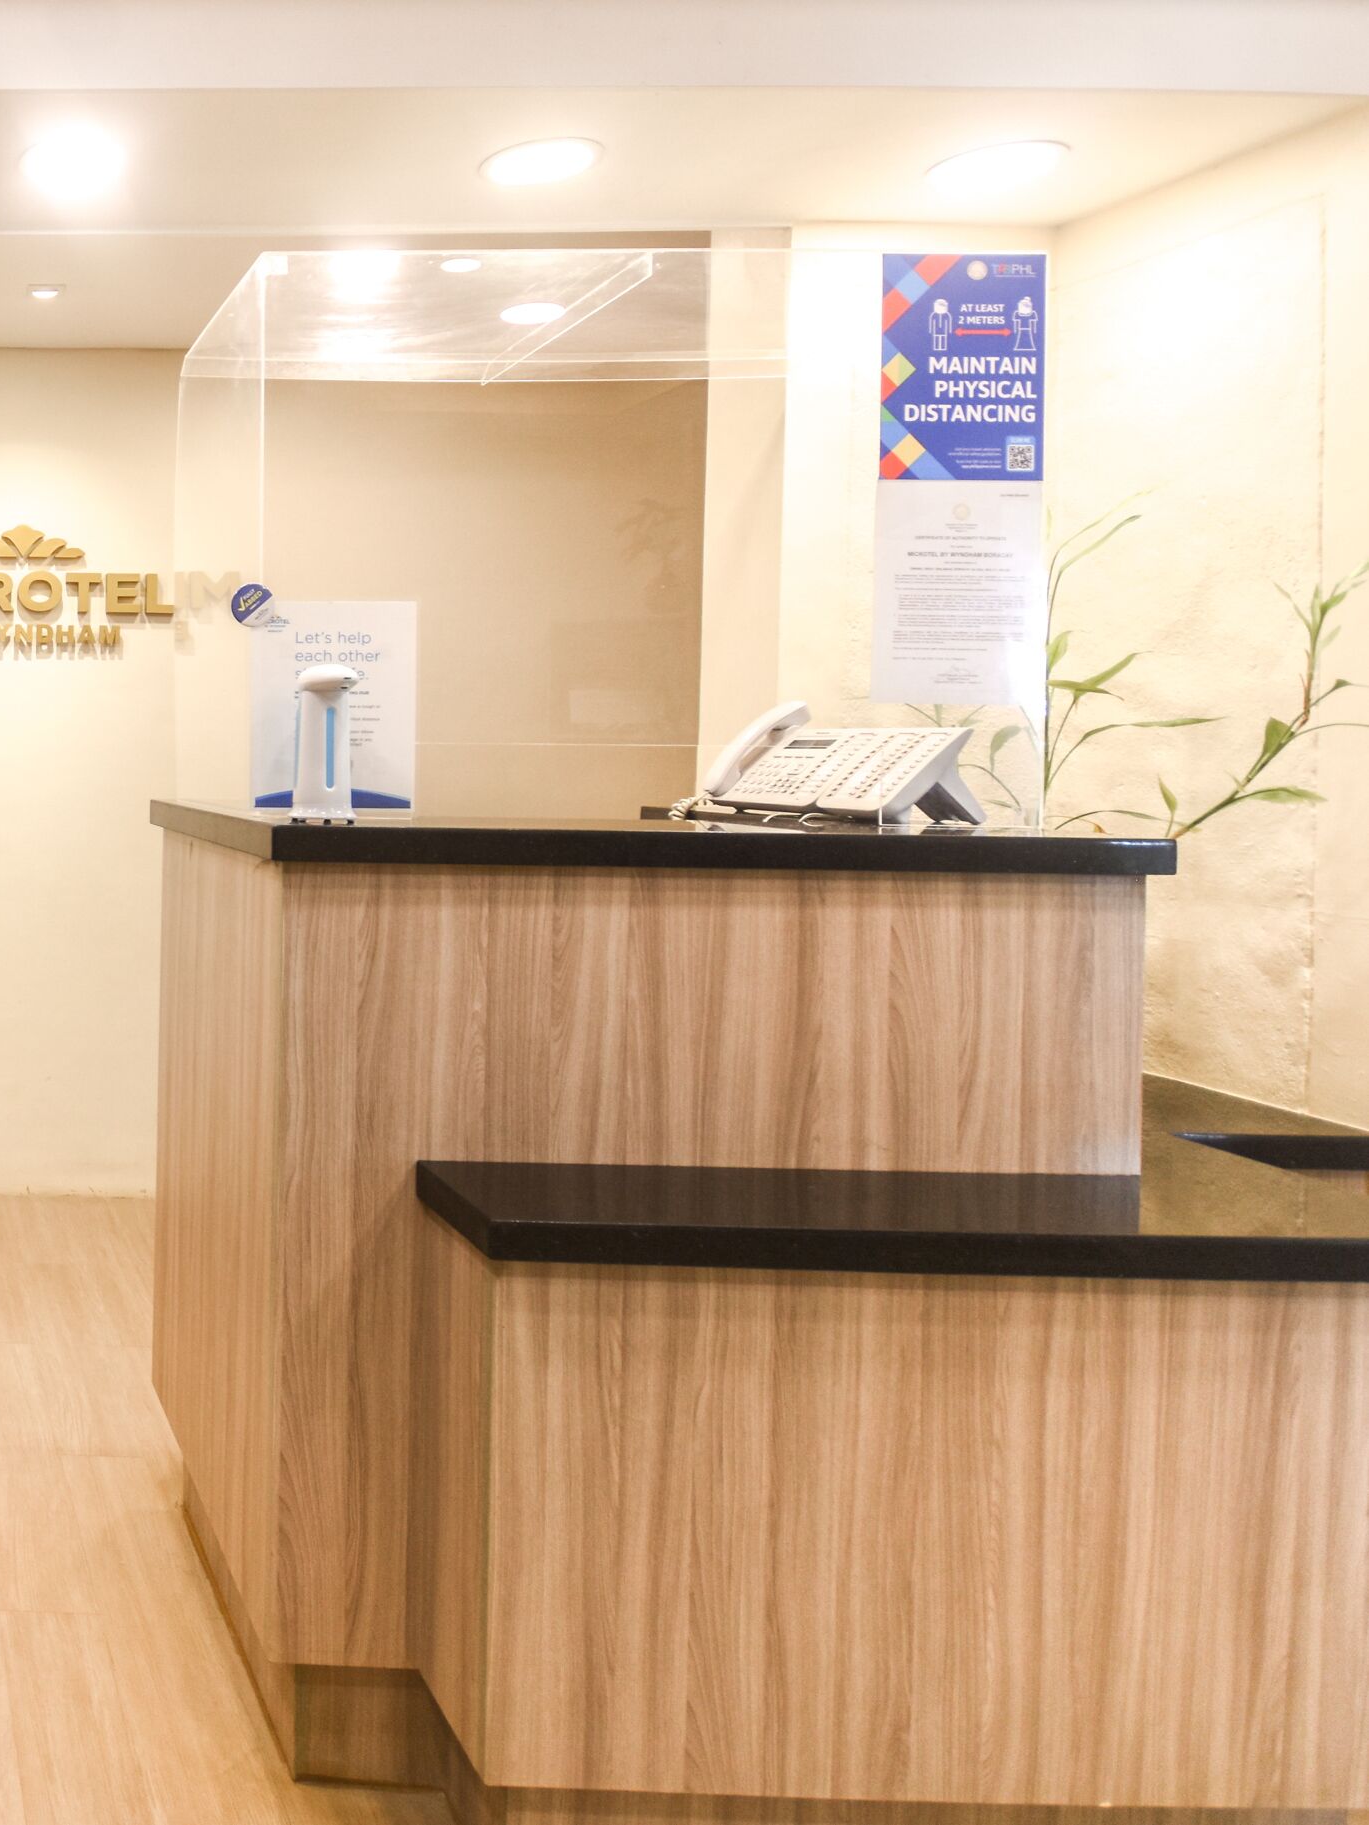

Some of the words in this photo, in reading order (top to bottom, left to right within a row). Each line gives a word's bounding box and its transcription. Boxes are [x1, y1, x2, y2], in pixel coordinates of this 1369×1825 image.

[960, 304, 973, 312] AT
[975, 304, 1005, 313] LEAST
[959, 316, 964, 324] 2
[966, 316, 1005, 325] METERS
[929, 356, 1037, 374] MAINTAIN
[935, 380, 1037, 398] PHYSICAL
[904, 404, 1036, 422] DISTANCING
[295, 631, 332, 644] Let's
[338, 631, 371, 645] help
[295, 650, 332, 662] each
[338, 650, 381, 662] other
